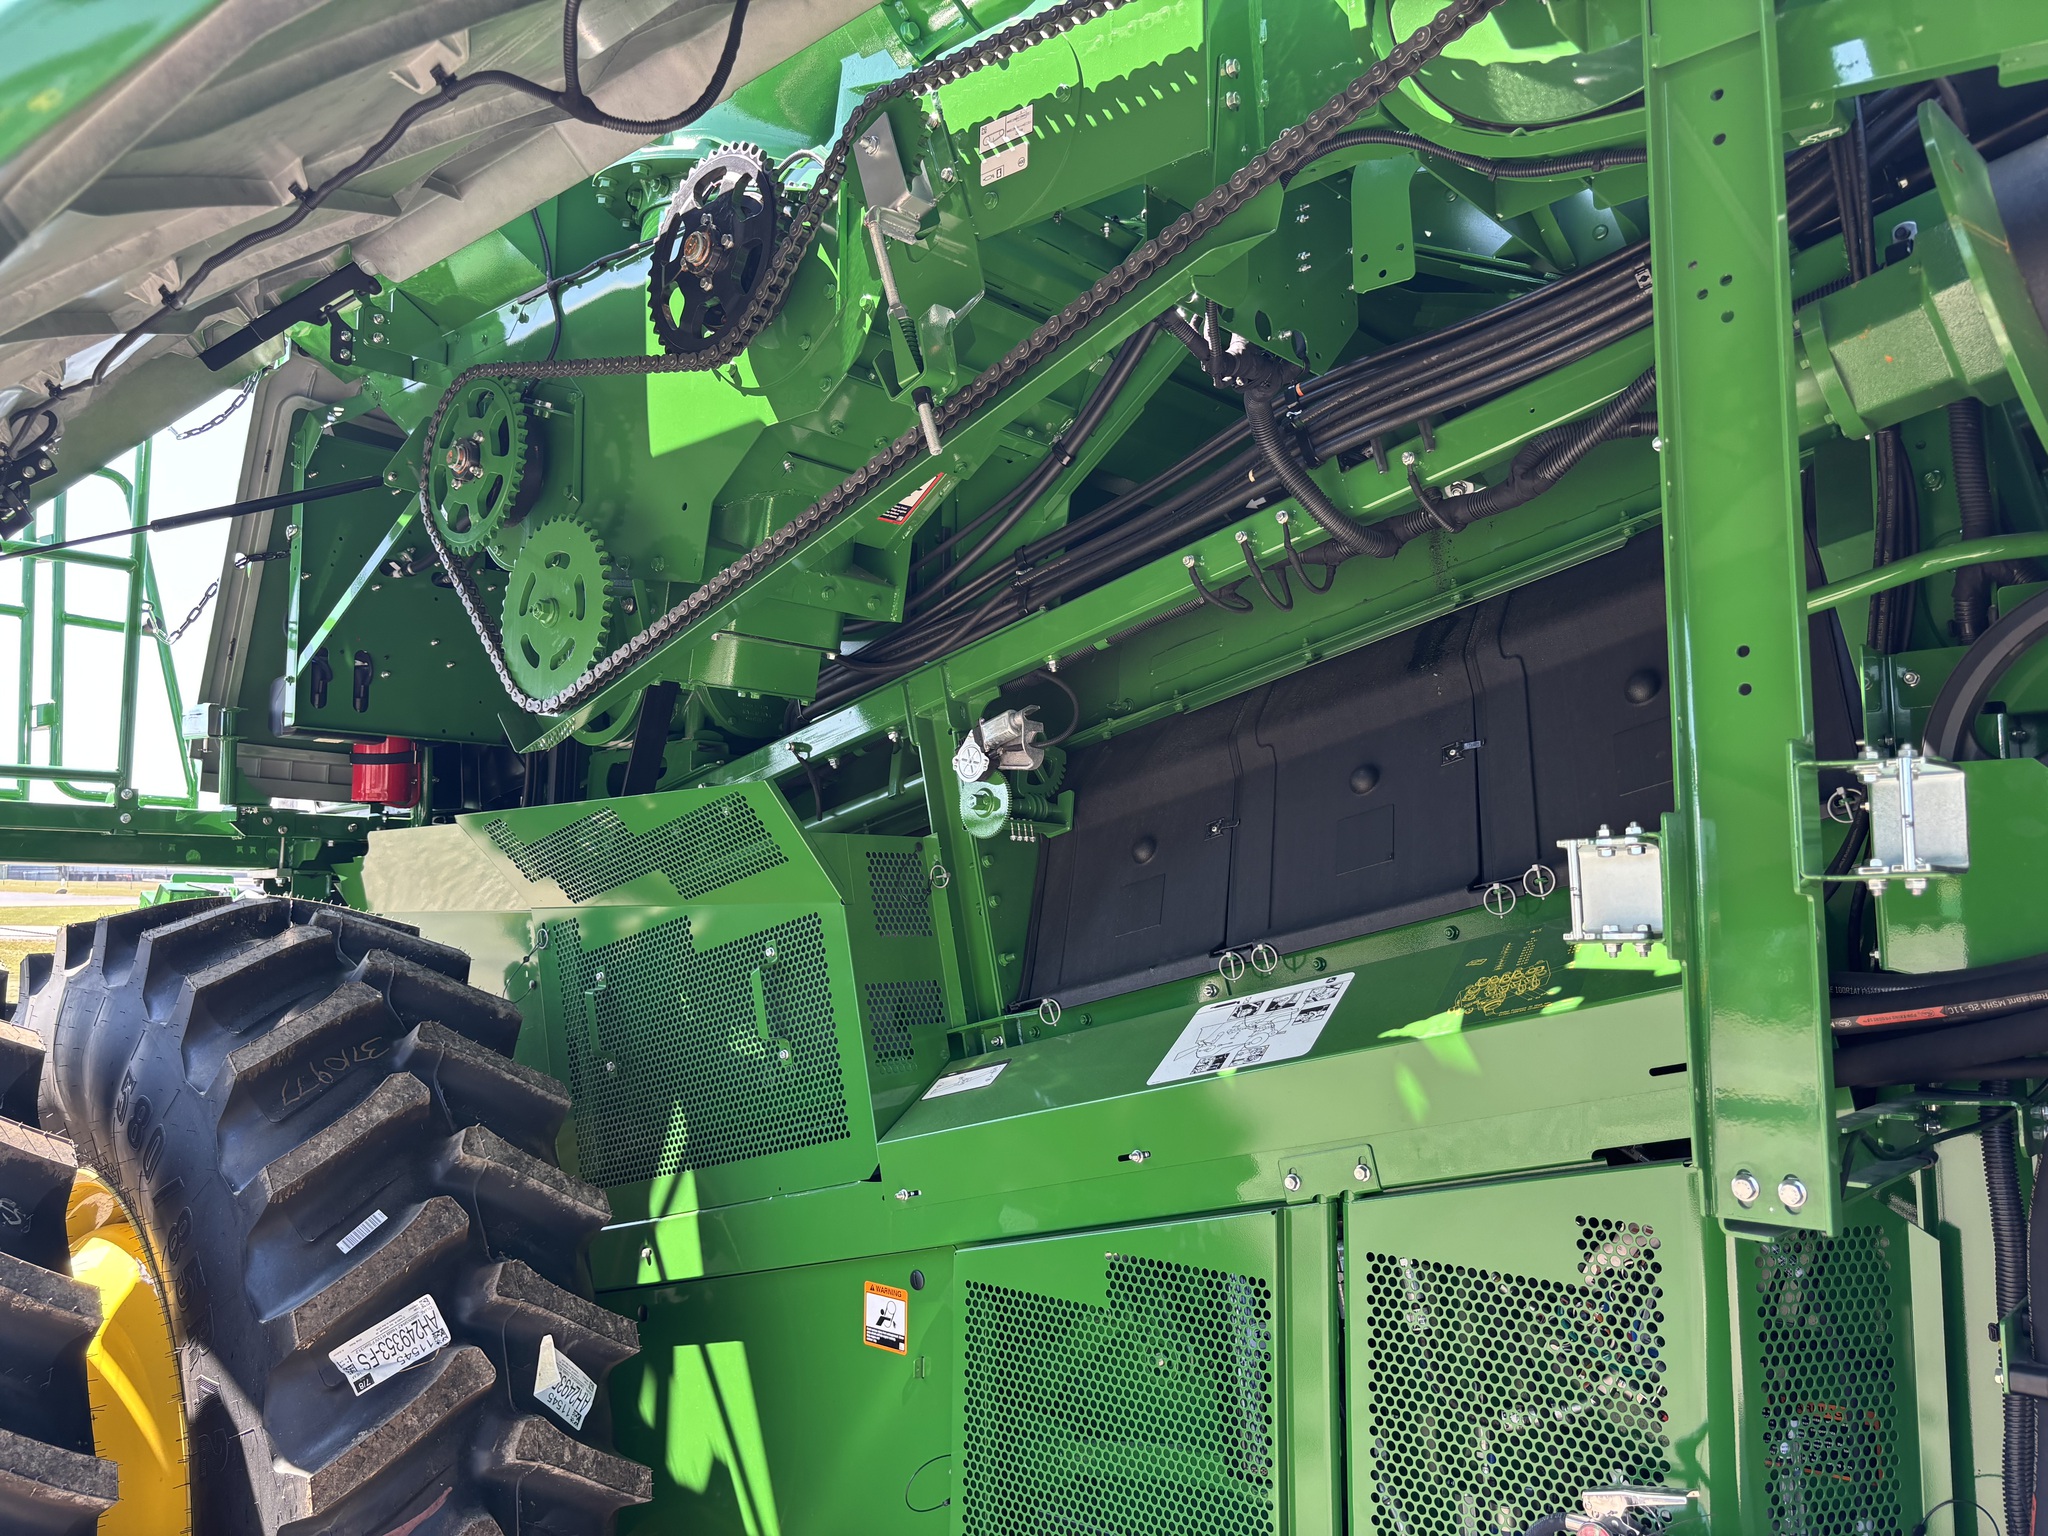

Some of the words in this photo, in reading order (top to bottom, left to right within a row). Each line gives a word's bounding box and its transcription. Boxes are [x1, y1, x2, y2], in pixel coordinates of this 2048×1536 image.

[1981, 1000, 2006, 1010] MSHA
[876, 1285, 902, 1298] WARNING
[356, 1309, 440, 1371] AH249353-FS
[396, 1339, 434, 1366] 11545
[358, 1379, 372, 1390] 7/8
[546, 1392, 571, 1418] 11545
